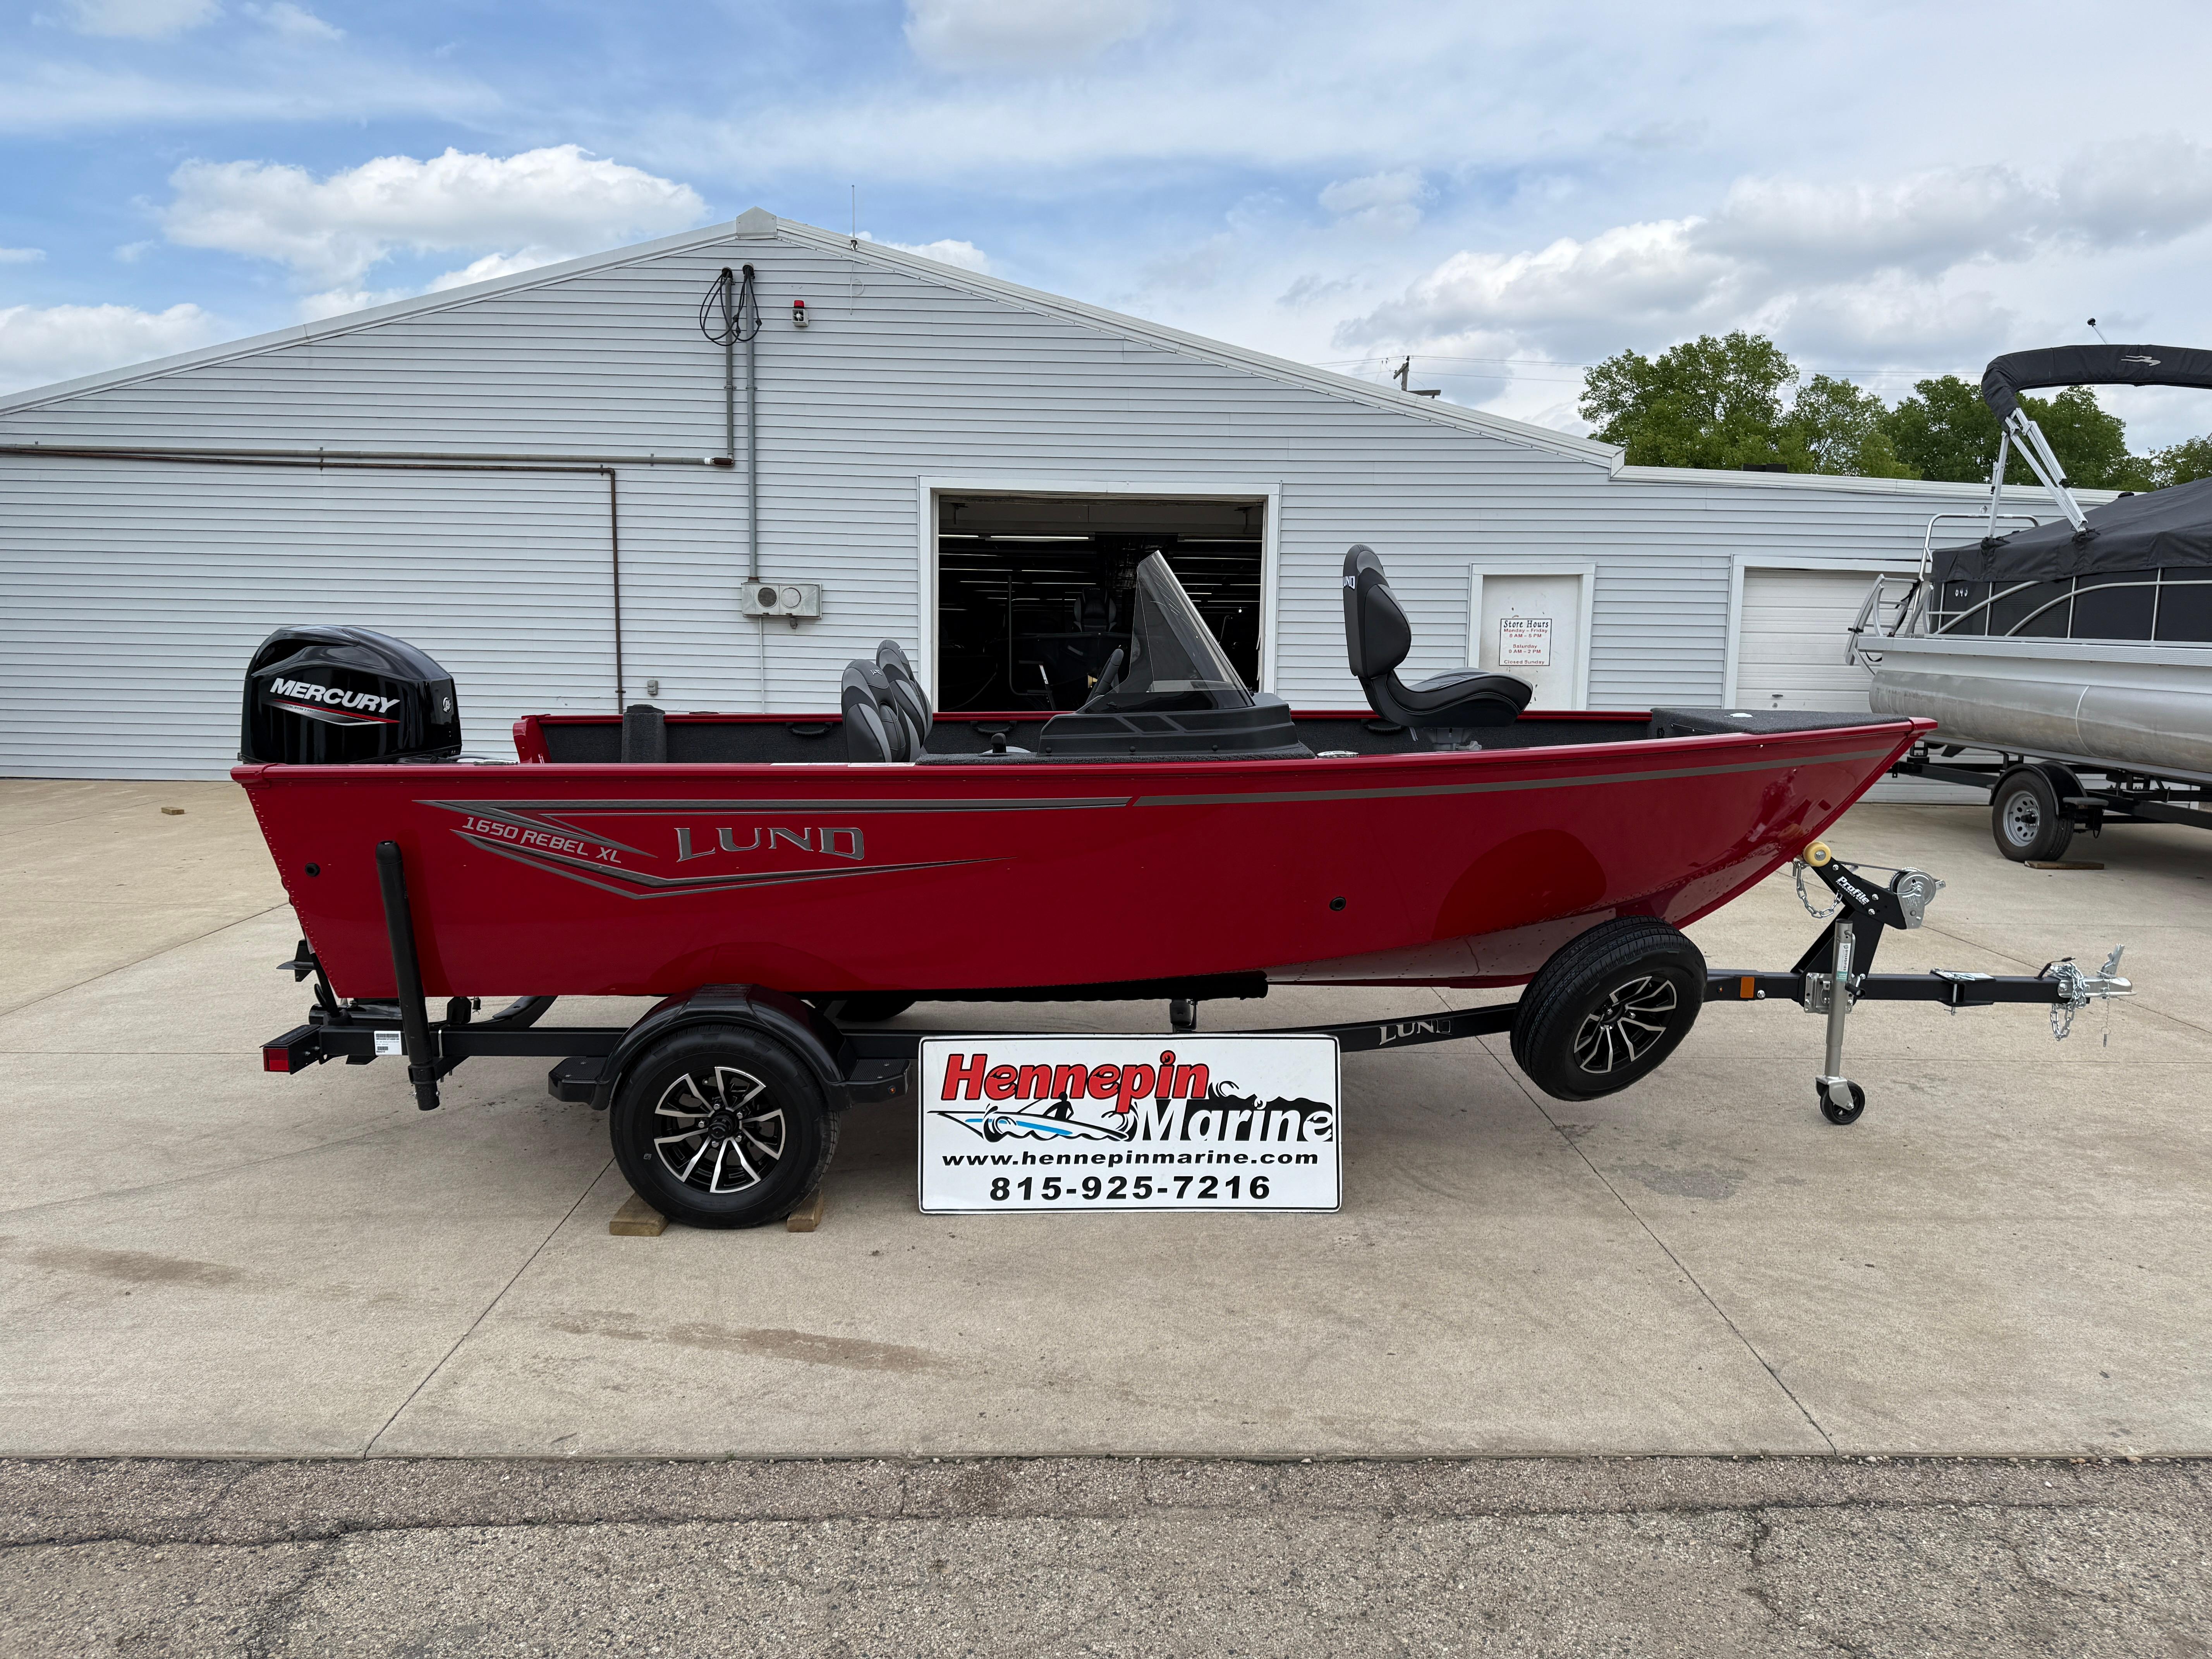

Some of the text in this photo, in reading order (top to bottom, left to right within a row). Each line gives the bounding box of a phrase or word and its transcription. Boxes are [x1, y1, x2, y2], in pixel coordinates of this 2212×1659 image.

[1343, 576, 1355, 589] UND
[270, 678, 400, 713] MERCURY
[462, 817, 621, 863] 1650 REBEL XL
[674, 827, 864, 863] LUND
[1837, 876, 1870, 904] Profile
[1379, 1020, 1452, 1045] LUND
[941, 1050, 1209, 1114] Hennepin
[1138, 1097, 1333, 1142] Marine
[942, 1150, 1318, 1168] www.hennepinmarine.com
[990, 1176, 1270, 1201] 815-925-7216
